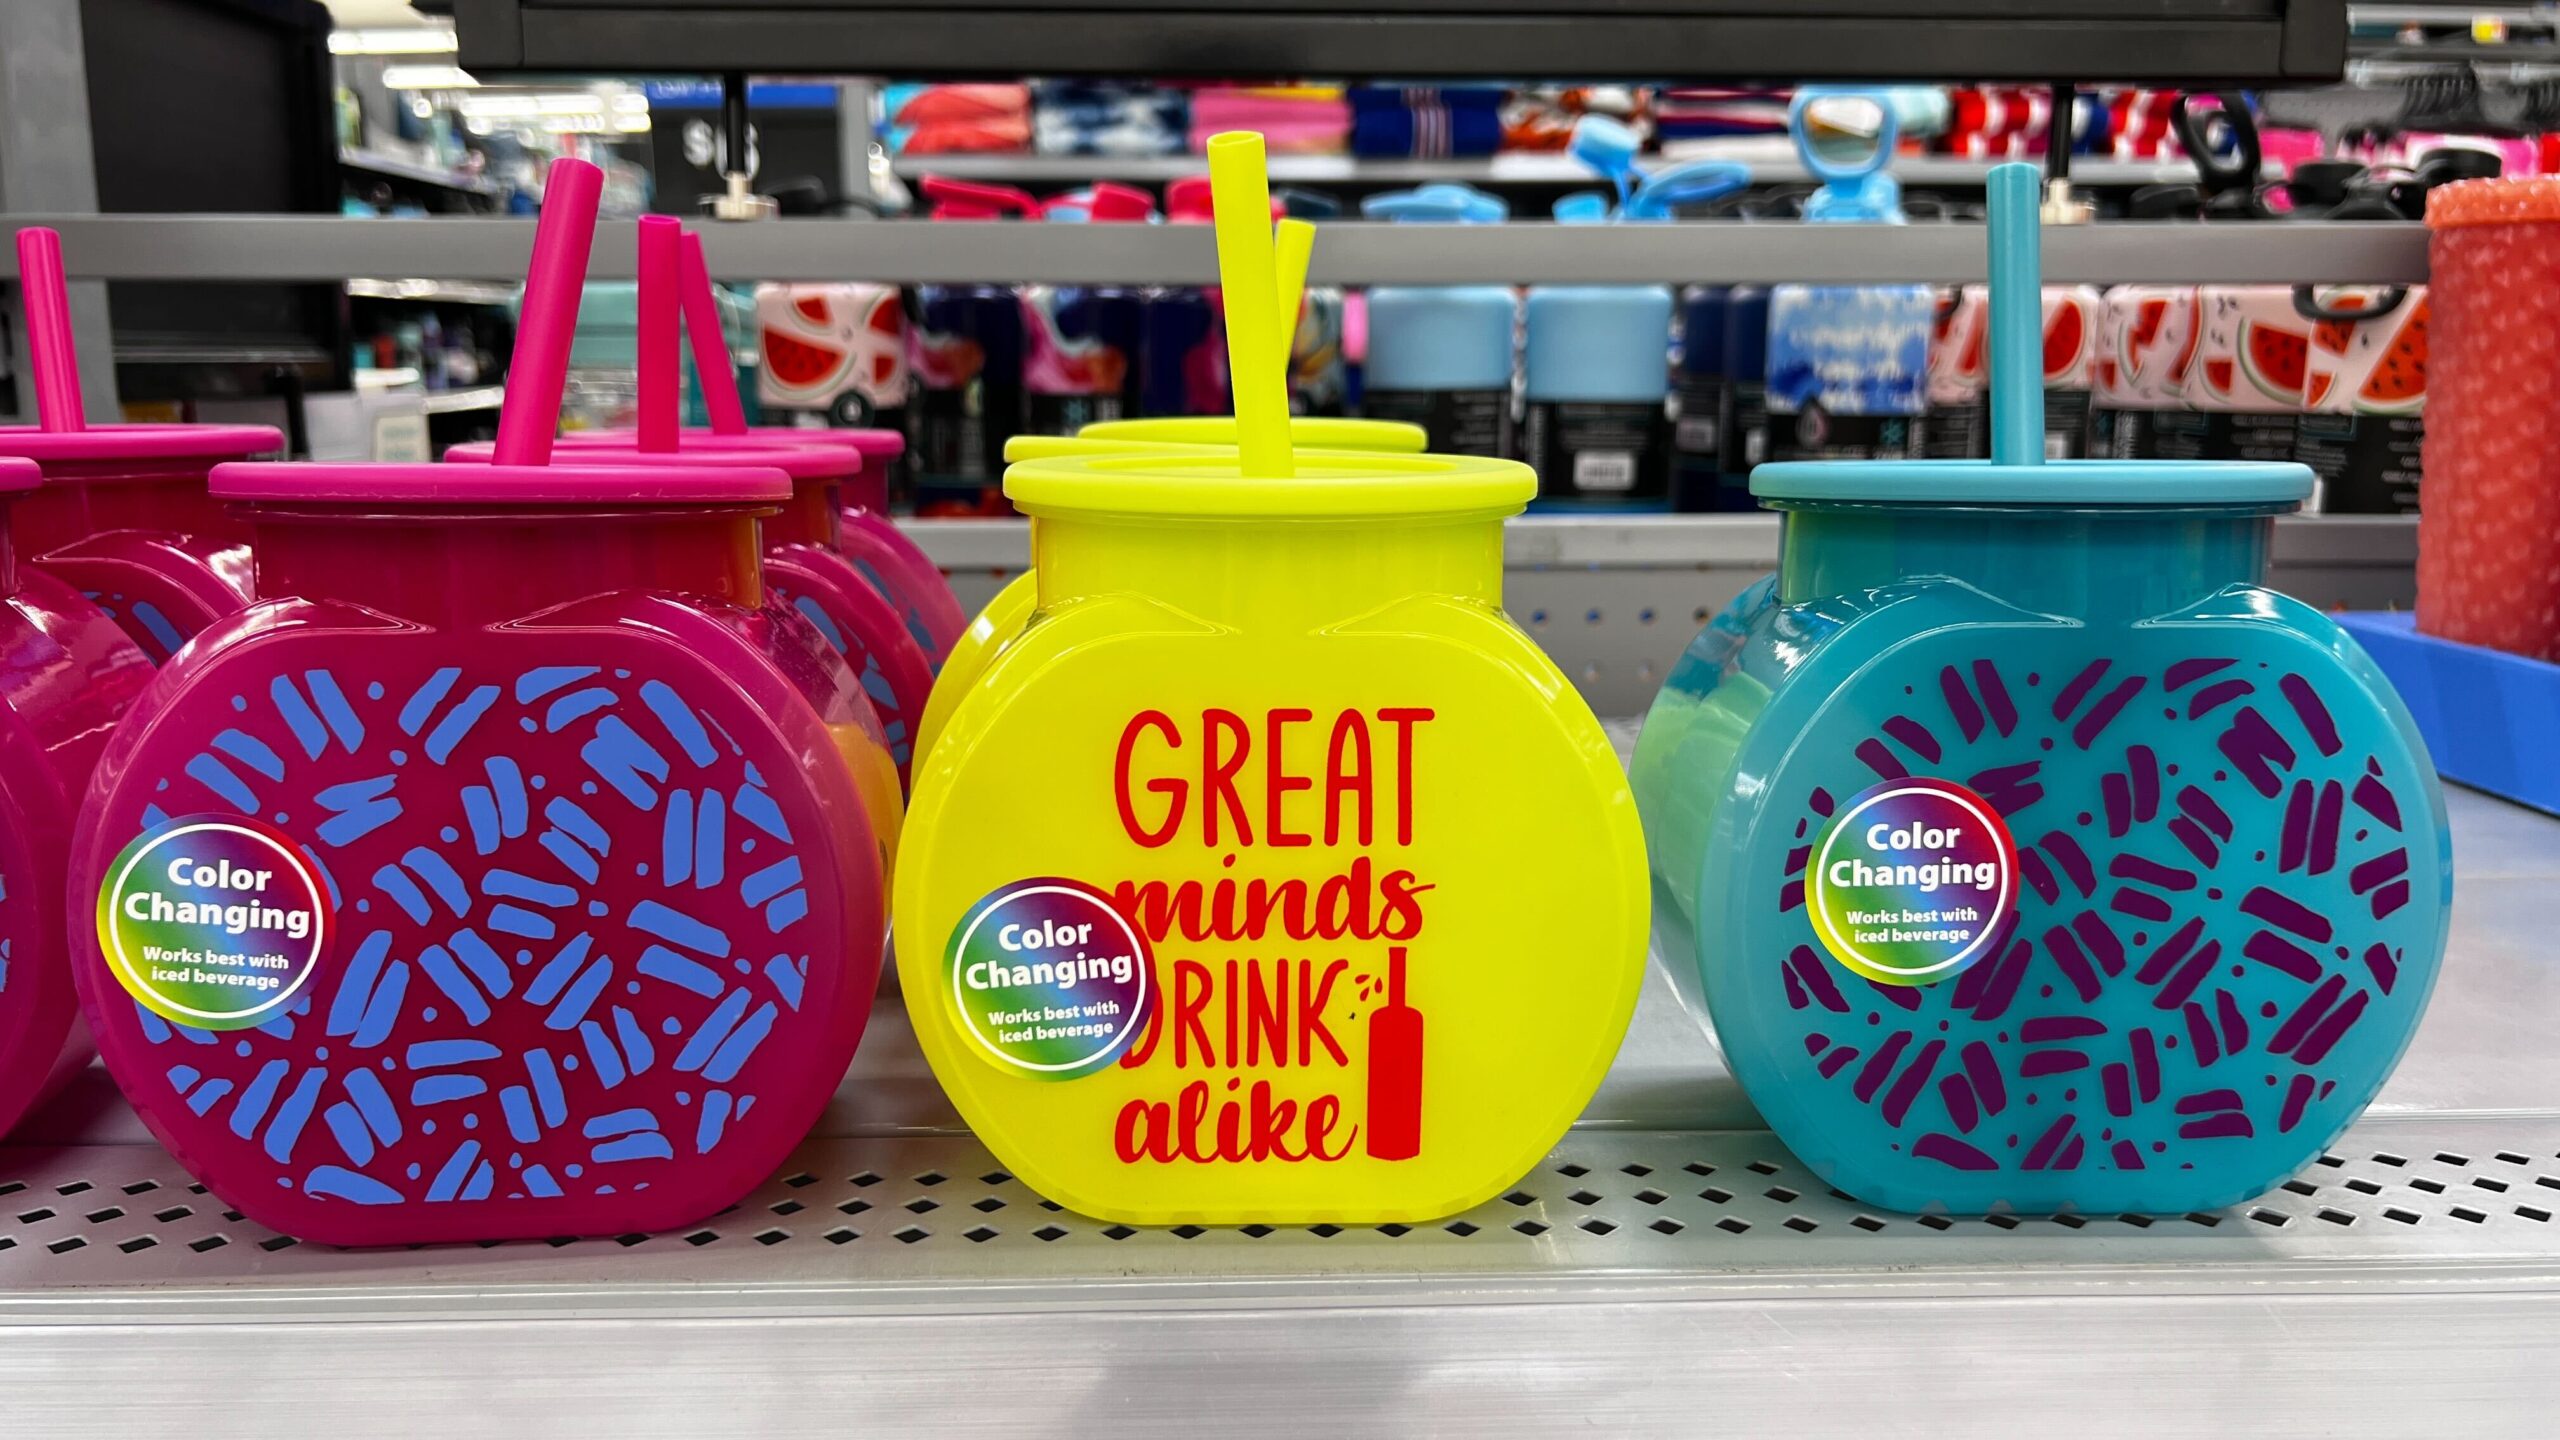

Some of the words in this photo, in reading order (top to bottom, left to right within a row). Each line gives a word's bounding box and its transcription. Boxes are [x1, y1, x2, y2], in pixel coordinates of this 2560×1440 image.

[1114, 707, 1436, 849] GREAT
[1866, 821, 1961, 851] Color
[167, 857, 273, 891] Color
[1828, 856, 1996, 893] Changing
[1113, 853, 1436, 942] minds
[124, 891, 310, 939] Changing
[1846, 909, 1899, 925] Works
[1902, 908, 1938, 923] best
[1941, 906, 1979, 922] with
[998, 919, 1093, 952] Color
[1854, 928, 1889, 944] iced
[1891, 928, 1971, 944] beverage
[142, 946, 202, 965] Works
[206, 949, 246, 967] best
[248, 953, 290, 970] with
[965, 951, 1133, 990] Changing
[151, 966, 190, 983] iced
[193, 968, 280, 991] beverage
[987, 1007, 1042, 1026] Works
[1044, 1005, 1081, 1021] best
[1082, 1000, 1120, 1017] with
[998, 1026, 1034, 1043] iced
[1036, 1021, 1114, 1041] beverage
[1114, 1077, 1359, 1164] alike
